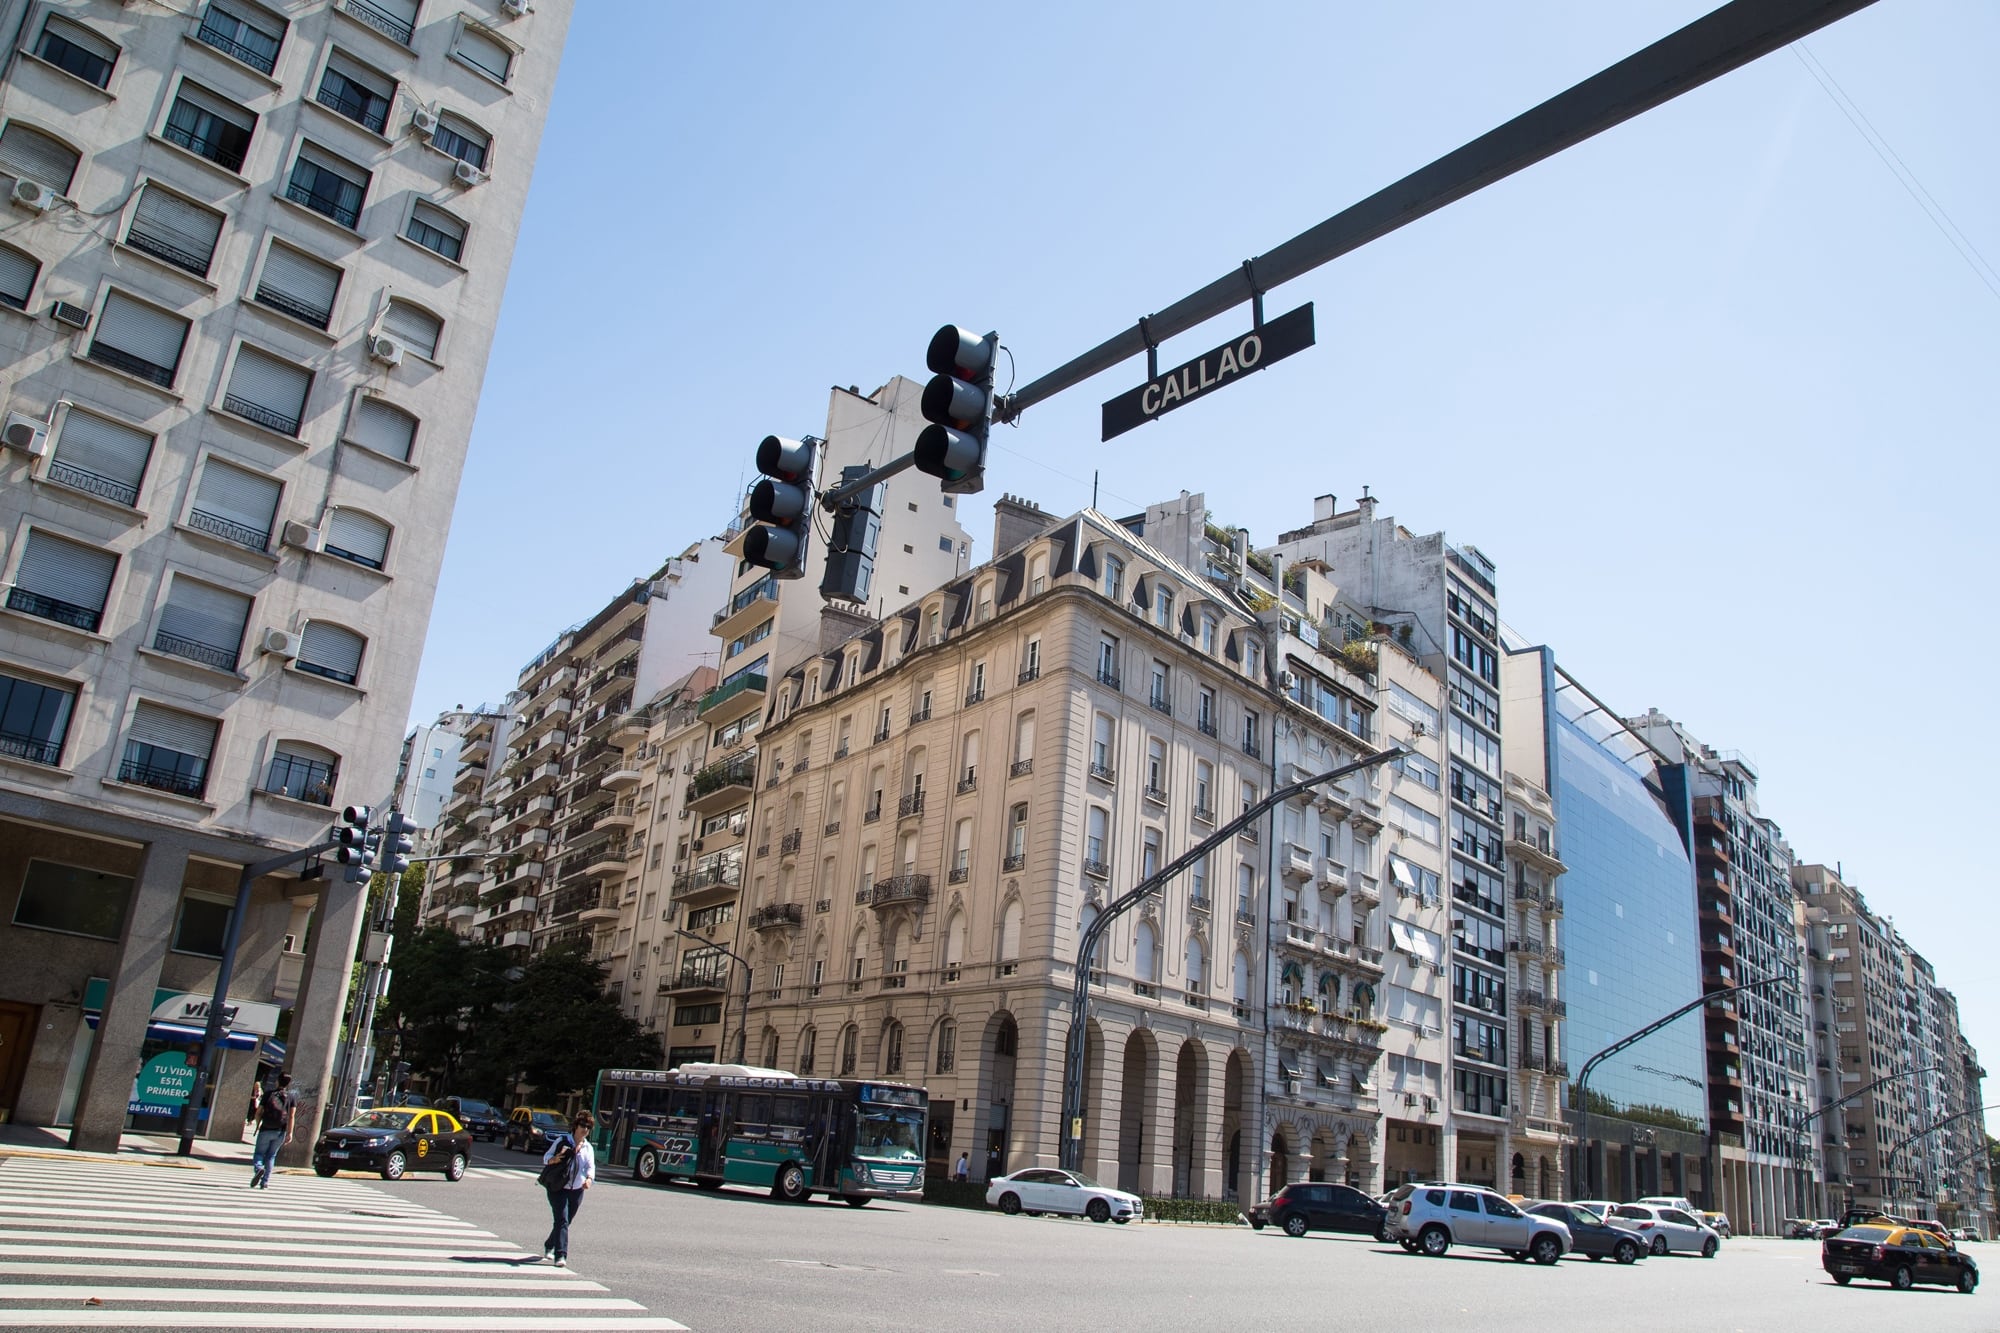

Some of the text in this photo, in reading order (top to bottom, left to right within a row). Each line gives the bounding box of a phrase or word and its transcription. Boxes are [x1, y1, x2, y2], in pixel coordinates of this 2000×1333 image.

[1142, 335, 1262, 415] CALLAO
[155, 1065, 193, 1077] TU VIDA
[611, 1070, 843, 1092] WILDE 17 RECOLETA
[146, 1086, 190, 1098] PRIMERO
